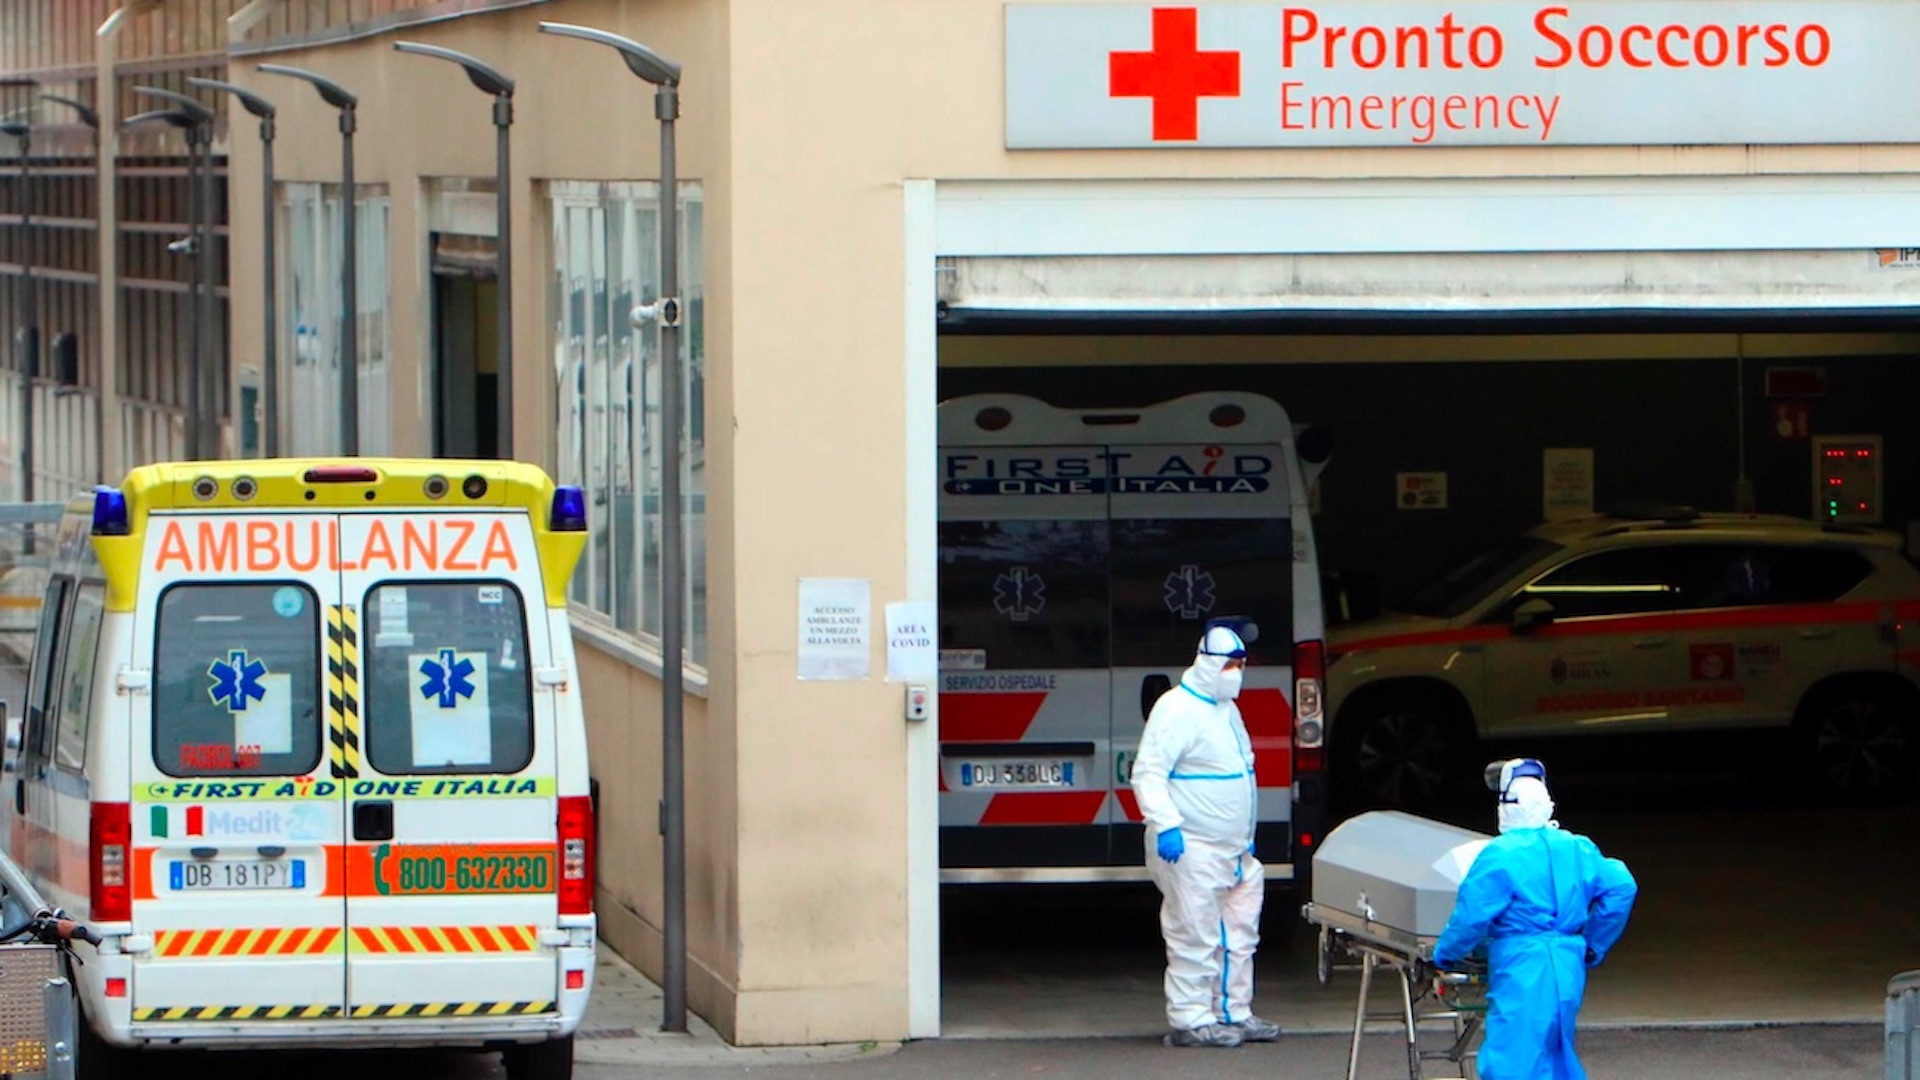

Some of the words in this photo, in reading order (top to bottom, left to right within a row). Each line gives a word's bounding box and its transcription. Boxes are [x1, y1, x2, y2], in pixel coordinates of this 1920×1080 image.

[1282, 8, 1504, 69] Pronto
[1534, 6, 1831, 68] Soccorso
[1281, 82, 1560, 143] Emergency
[946, 453, 1131, 477] FIRST
[1000, 480, 1092, 494] ONE
[1119, 478, 1257, 493] ITALIA
[155, 519, 518, 573] AMBULANZA
[481, 591, 501, 600] NCC
[814, 606, 855, 614] ACCESSO
[806, 616, 861, 624] AMBULANZE
[810, 626, 823, 635] UN
[825, 626, 858, 635] MEZZO
[897, 625, 927, 634] AREA
[807, 636, 831, 645] ALLA
[832, 636, 861, 645] VOLTA
[891, 638, 930, 648] COVID
[945, 675, 996, 690] SERVIZIO
[1000, 674, 1057, 689] OSPEDALE
[173, 783, 266, 798] FIRST
[353, 780, 423, 796] ONE
[433, 779, 537, 795] ITALIA
[208, 810, 282, 834] Medit
[186, 864, 213, 887] DB
[400, 856, 548, 889] 800-632330
